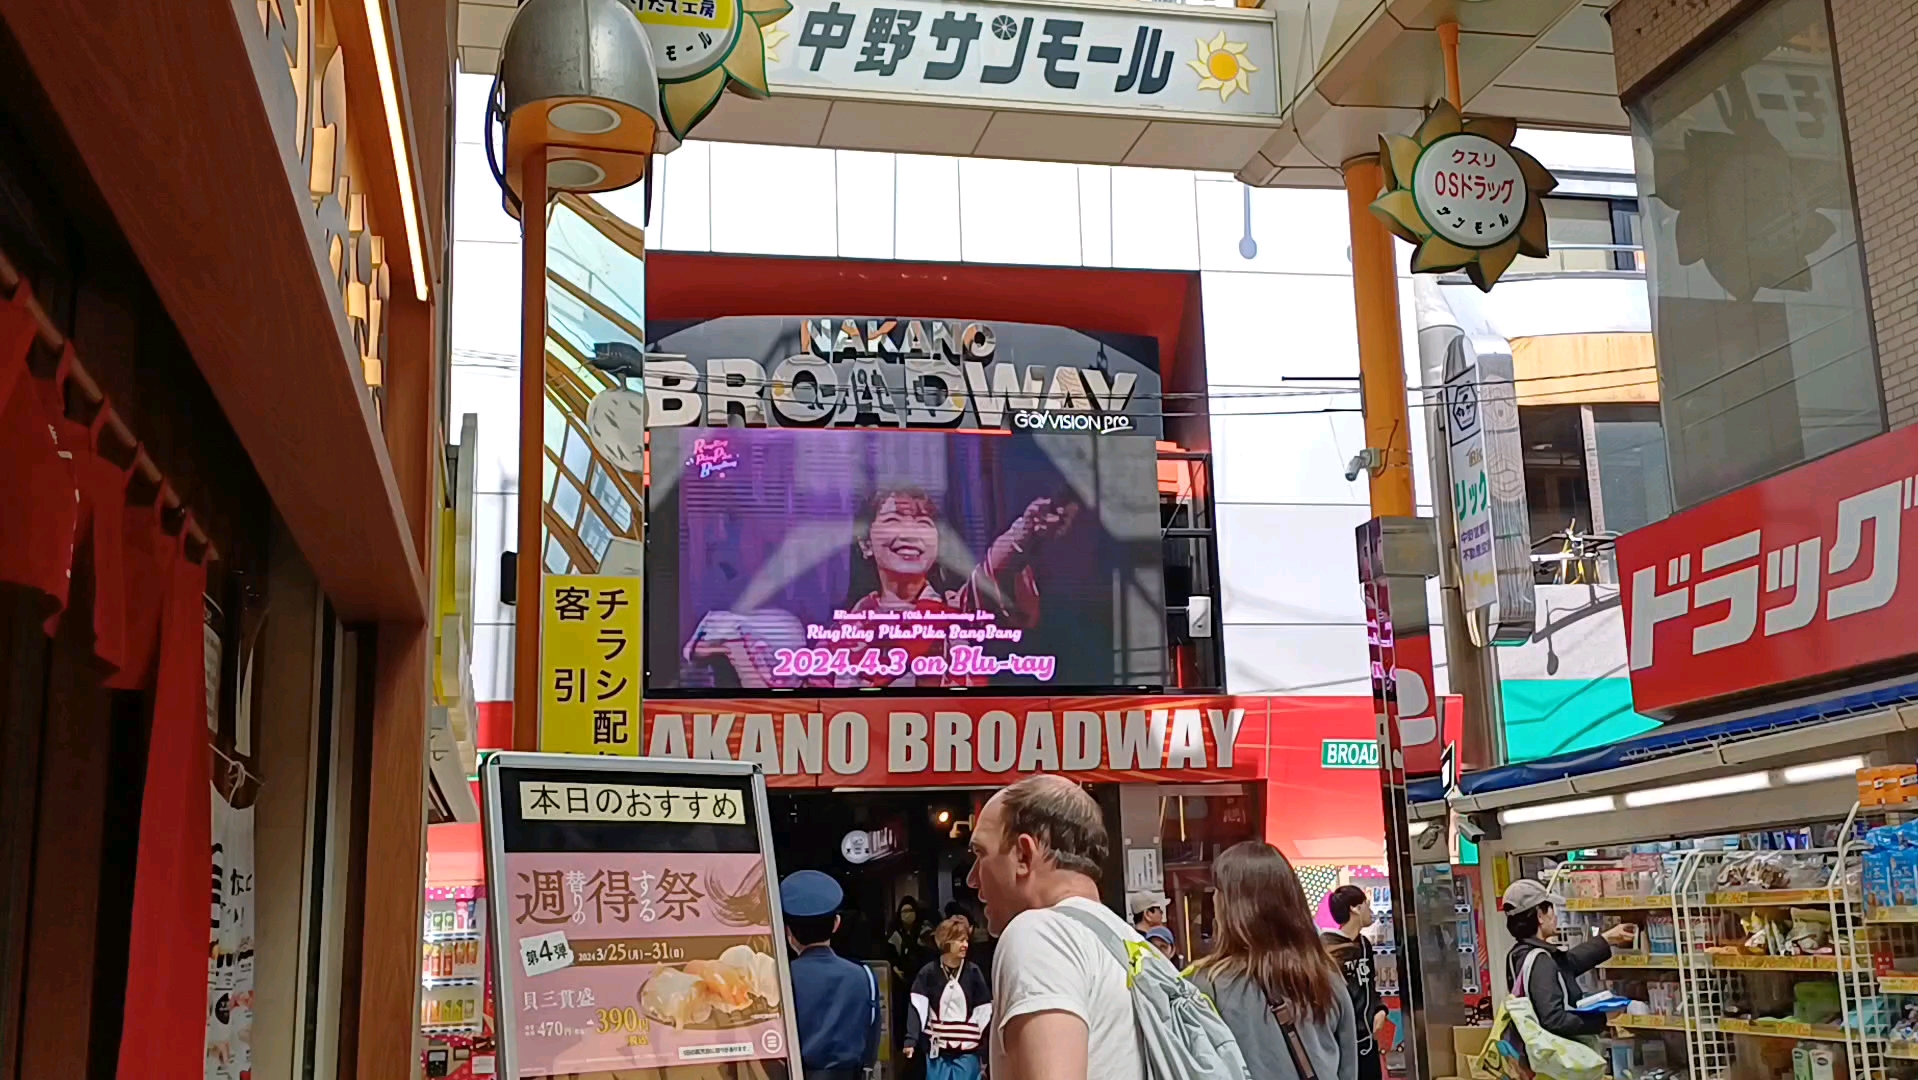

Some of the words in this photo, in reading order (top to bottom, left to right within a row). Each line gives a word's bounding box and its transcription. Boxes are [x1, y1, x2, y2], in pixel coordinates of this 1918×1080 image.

[798, 2, 1175, 94] 中野サンモール
[1452, 149, 1496, 168] クスリ
[1435, 171, 1514, 204] OSドラッグ
[1437, 206, 1509, 235] サンモール
[801, 318, 997, 361] NAKANO
[645, 354, 1138, 428] BROADWAY
[1455, 470, 1488, 521] リック
[1630, 475, 1918, 671] ドラッグ
[807, 624, 873, 642] RingRing
[878, 624, 946, 640] PikaPika
[949, 624, 1021, 642] BangBang
[555, 586, 590, 756] 客引
[593, 589, 629, 756] チラシ配
[773, 648, 908, 677] 2024.4.3
[911, 654, 948, 677] on
[949, 646, 1056, 681] Blu-ray
[888, 708, 1246, 773] BROADWAY
[1326, 743, 1379, 765] BROAD
[529, 784, 737, 820] 本日のおすすめ
[526, 940, 568, 966] 第4弾
